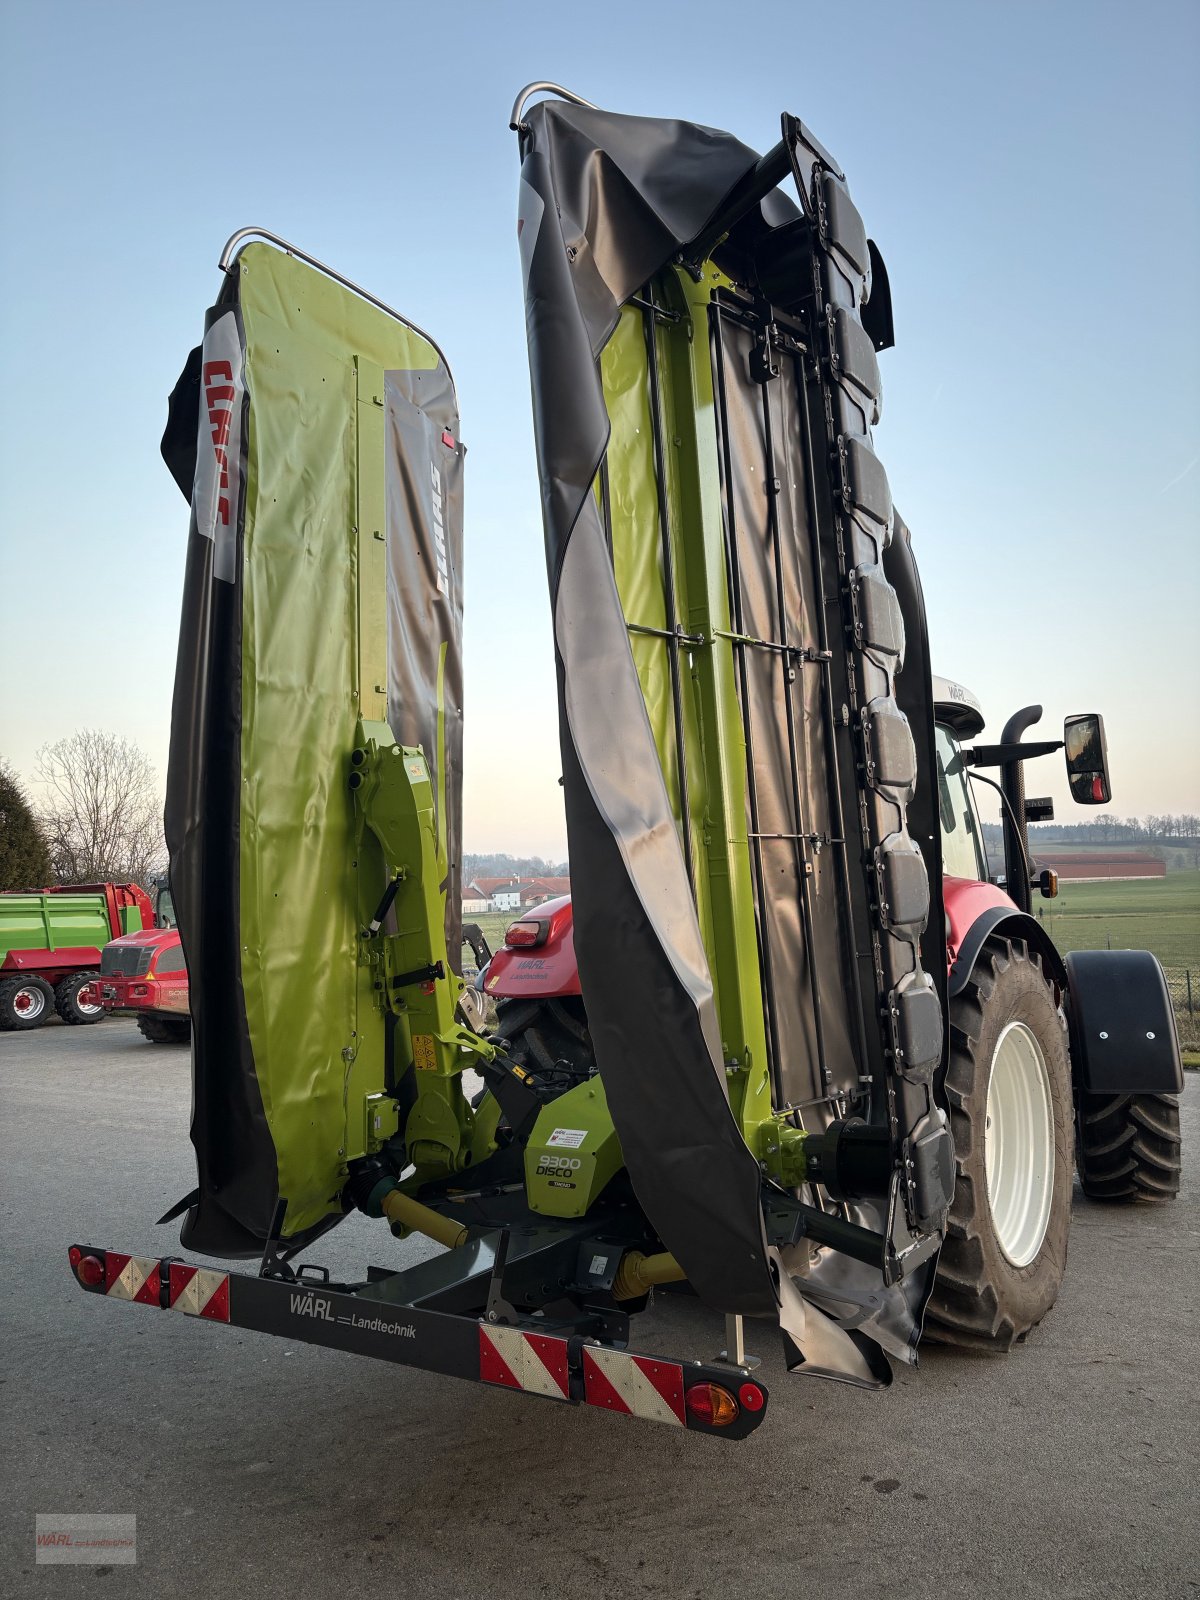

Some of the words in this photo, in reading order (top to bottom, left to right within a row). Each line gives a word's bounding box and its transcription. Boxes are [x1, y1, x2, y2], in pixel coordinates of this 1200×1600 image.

[430, 461, 449, 600] CLAAS
[536, 1166, 572, 1178] DISCO
[540, 1155, 581, 1169] 9300
[290, 1292, 335, 1321] WÄRL
[351, 1313, 416, 1338] Landtechnik
